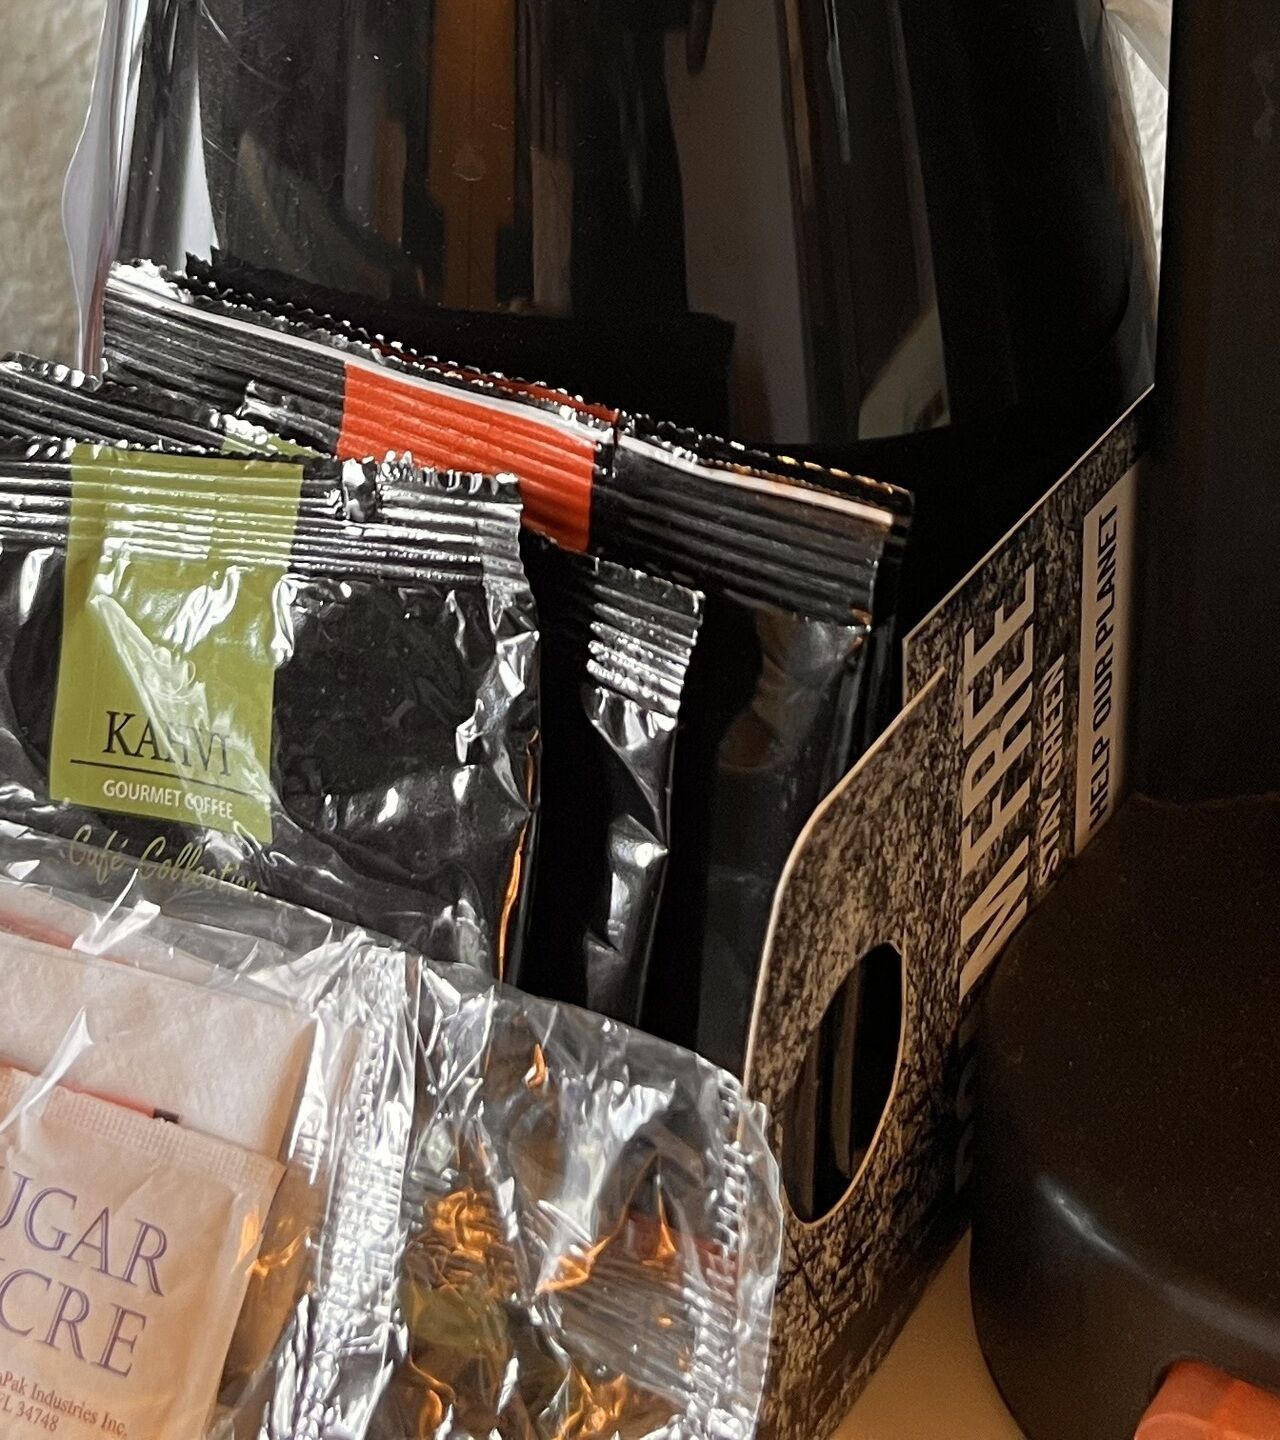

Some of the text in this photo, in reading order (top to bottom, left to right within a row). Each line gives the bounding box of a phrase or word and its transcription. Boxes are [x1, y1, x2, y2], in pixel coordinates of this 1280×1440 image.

[1088, 503, 1119, 830] HELP OUR PLANET
[961, 562, 1035, 878] FREE
[1041, 654, 1066, 792] GREEN
[103, 779, 234, 820] GOURMET COFFEE
[1039, 789, 1063, 886] STAY
[136, 836, 259, 893] Collection
[16, 1400, 61, 1433] 34748
[30, 1381, 98, 1426] Industries
